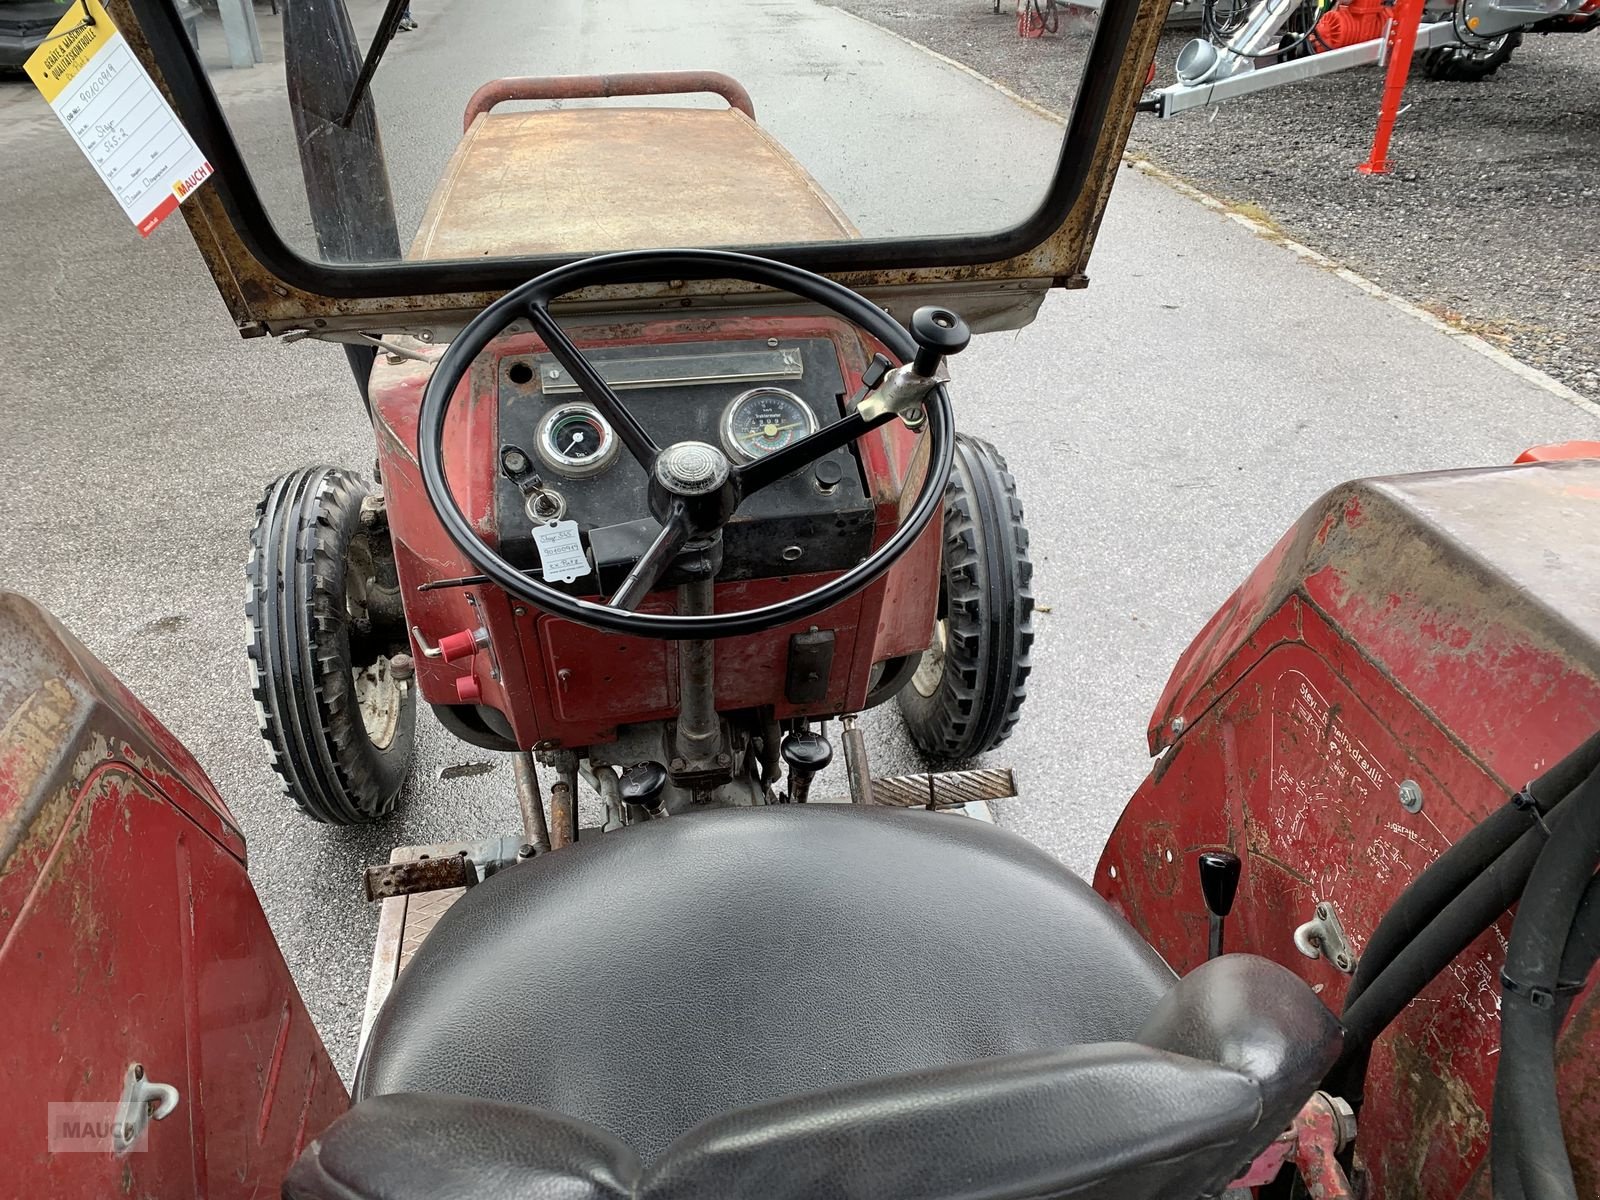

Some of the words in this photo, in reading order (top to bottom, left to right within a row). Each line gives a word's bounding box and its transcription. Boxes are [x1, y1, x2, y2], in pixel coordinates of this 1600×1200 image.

[44, 48, 61, 69] GERÄTE
[58, 44, 66, 53] &
[52, 28, 96, 80] QUALITÄTSKONTROLLE
[80, 63, 117, 103] 90100919
[177, 166, 207, 197] MAUCH
